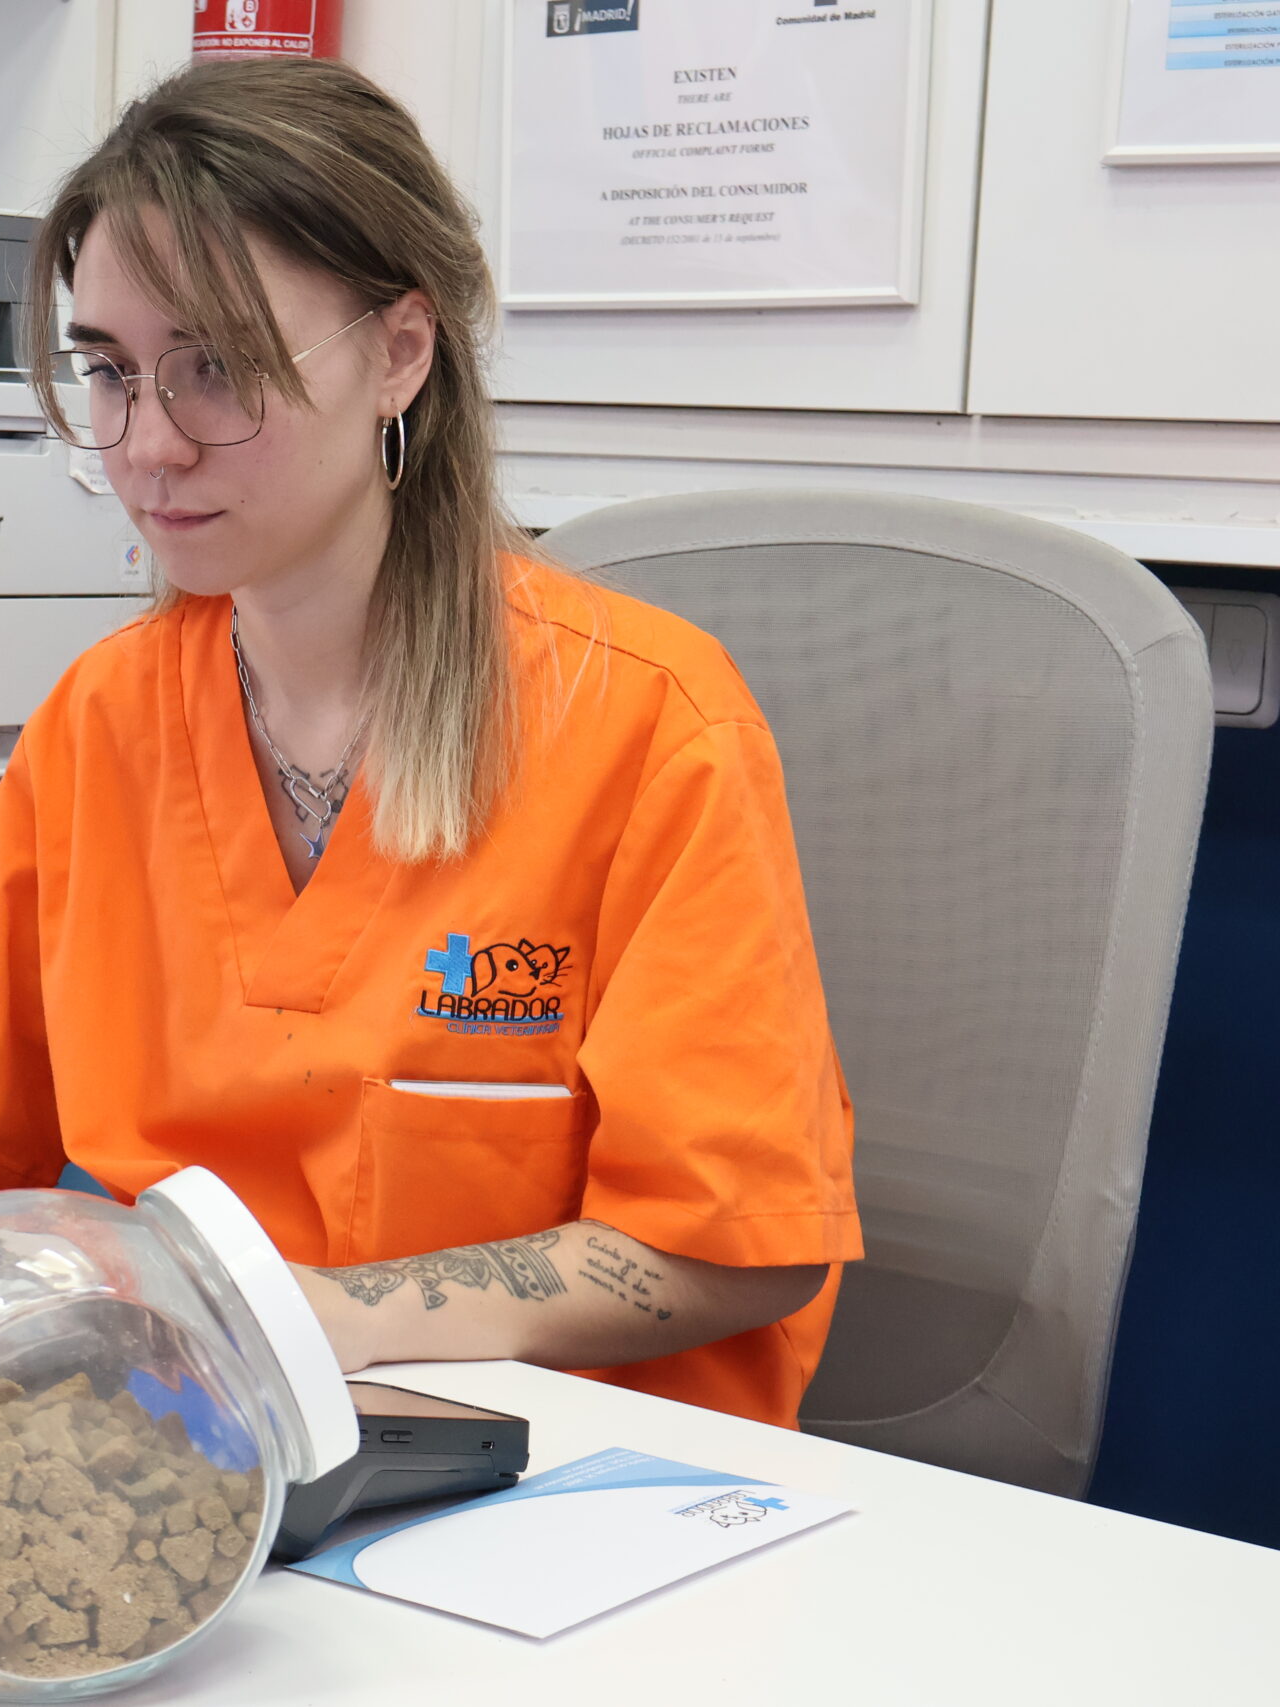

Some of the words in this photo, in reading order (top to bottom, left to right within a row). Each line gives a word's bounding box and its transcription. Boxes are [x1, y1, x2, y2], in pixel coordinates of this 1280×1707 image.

[775, 15, 827, 26] Comunidad
[830, 13, 841, 22] de
[844, 10, 876, 20] Madrid
[673, 67, 738, 84] EXISTEN
[603, 125, 649, 140] HOJAS
[652, 124, 671, 137] DE
[676, 116, 810, 136] RECLAMACIONES
[600, 191, 608, 201] A
[611, 184, 688, 200] DISPOSICIÓN
[691, 186, 715, 198] DEL
[719, 182, 808, 197] CONSUMIDOR
[420, 990, 561, 1021] LABRADOR
